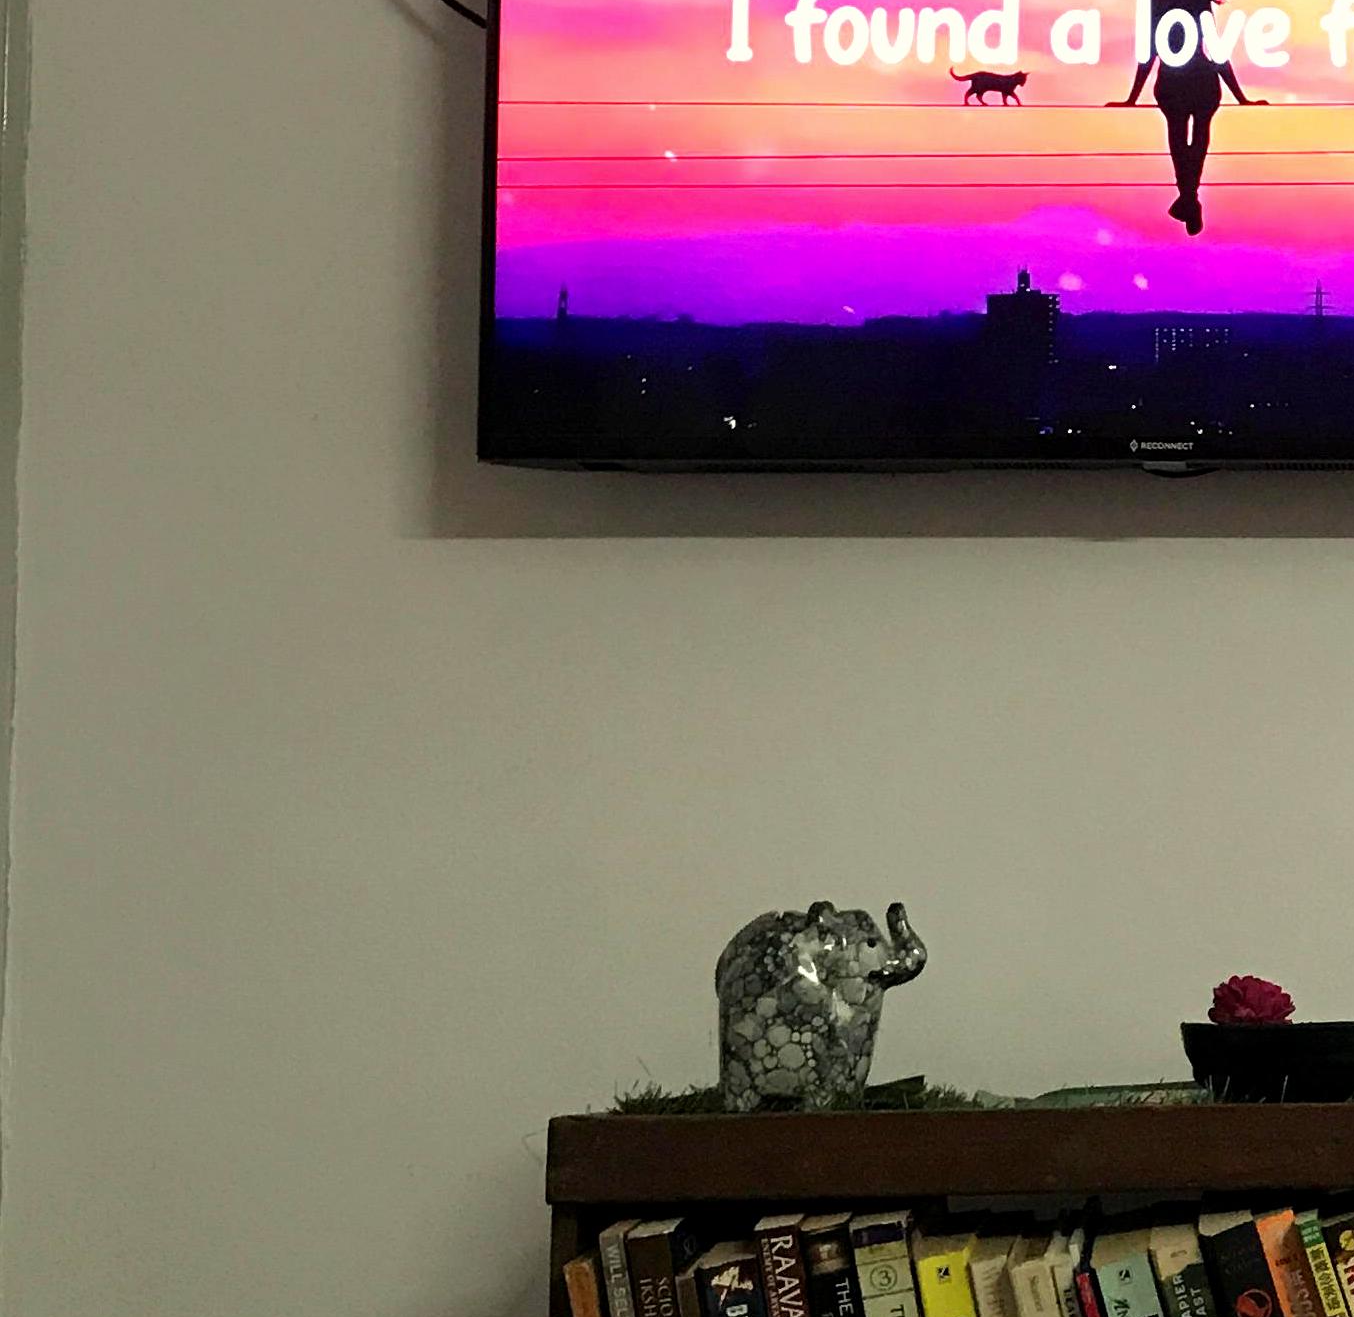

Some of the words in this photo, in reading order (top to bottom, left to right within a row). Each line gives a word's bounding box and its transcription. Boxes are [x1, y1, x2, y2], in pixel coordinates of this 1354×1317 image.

[1049, 9, 1101, 65] a
[604, 1243, 622, 1280] WILL
[835, 1278, 854, 1316] THE
